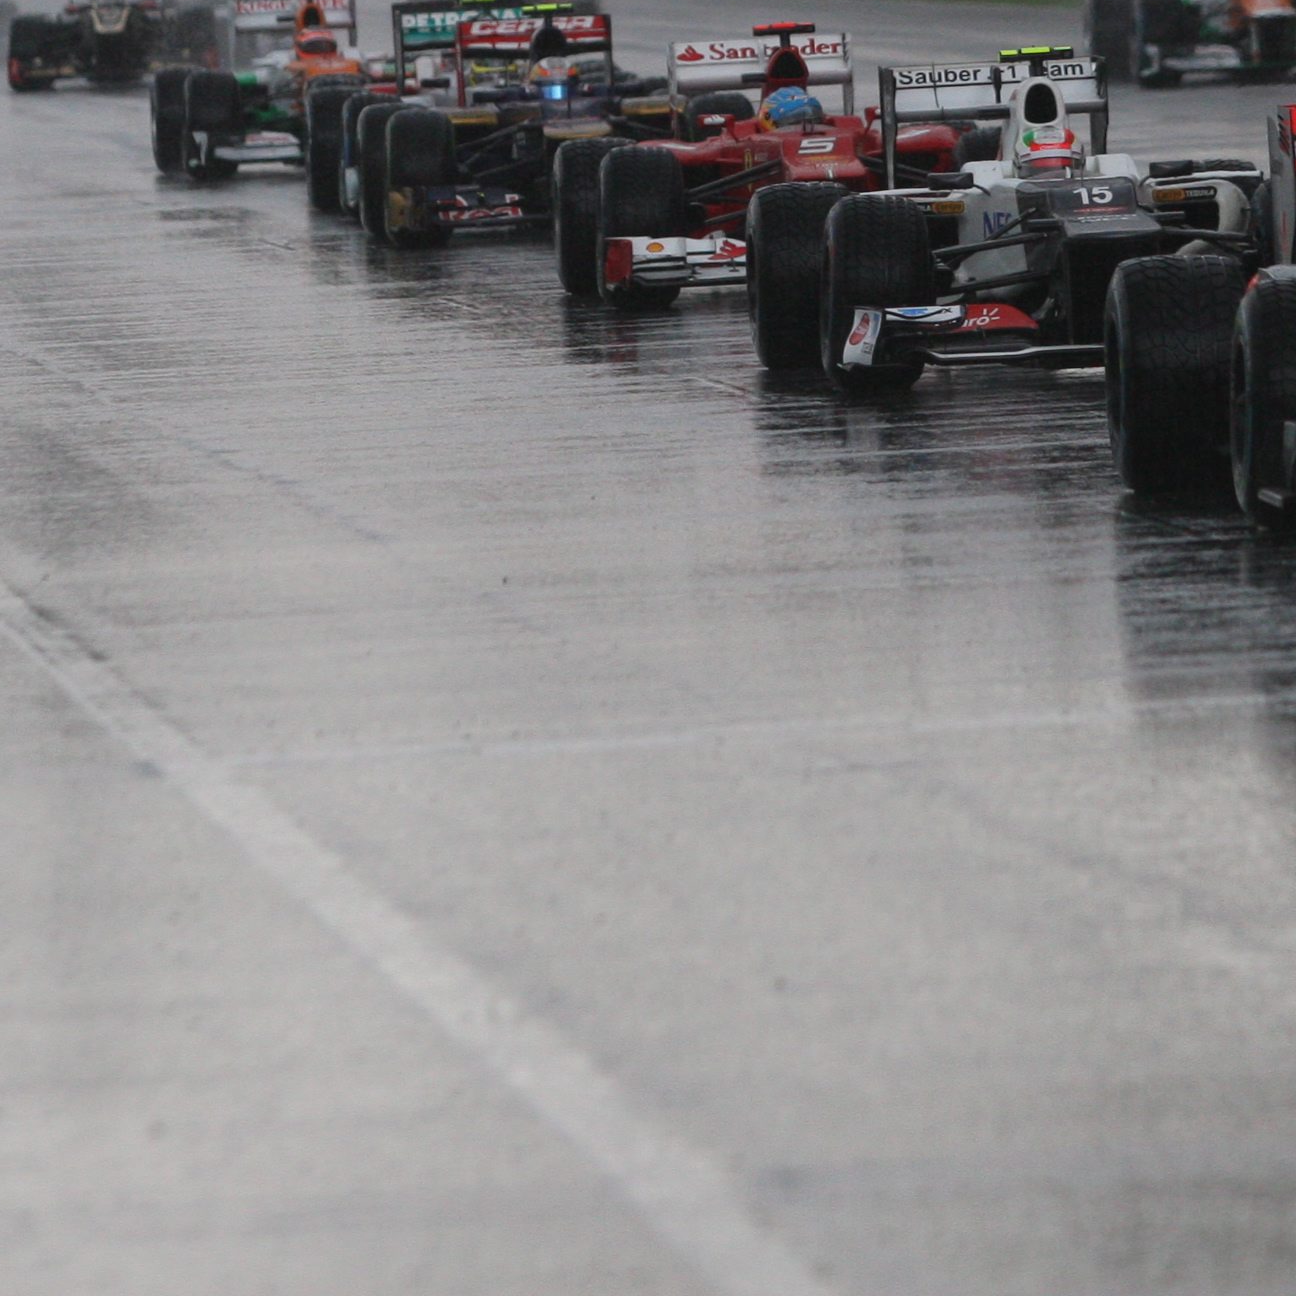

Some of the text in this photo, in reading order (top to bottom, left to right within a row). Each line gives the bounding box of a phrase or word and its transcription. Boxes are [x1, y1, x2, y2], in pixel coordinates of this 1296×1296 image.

[708, 37, 842, 60] Santder
[899, 67, 981, 85] Sauber
[798, 137, 838, 155] 5
[1072, 186, 1114, 206] 15
